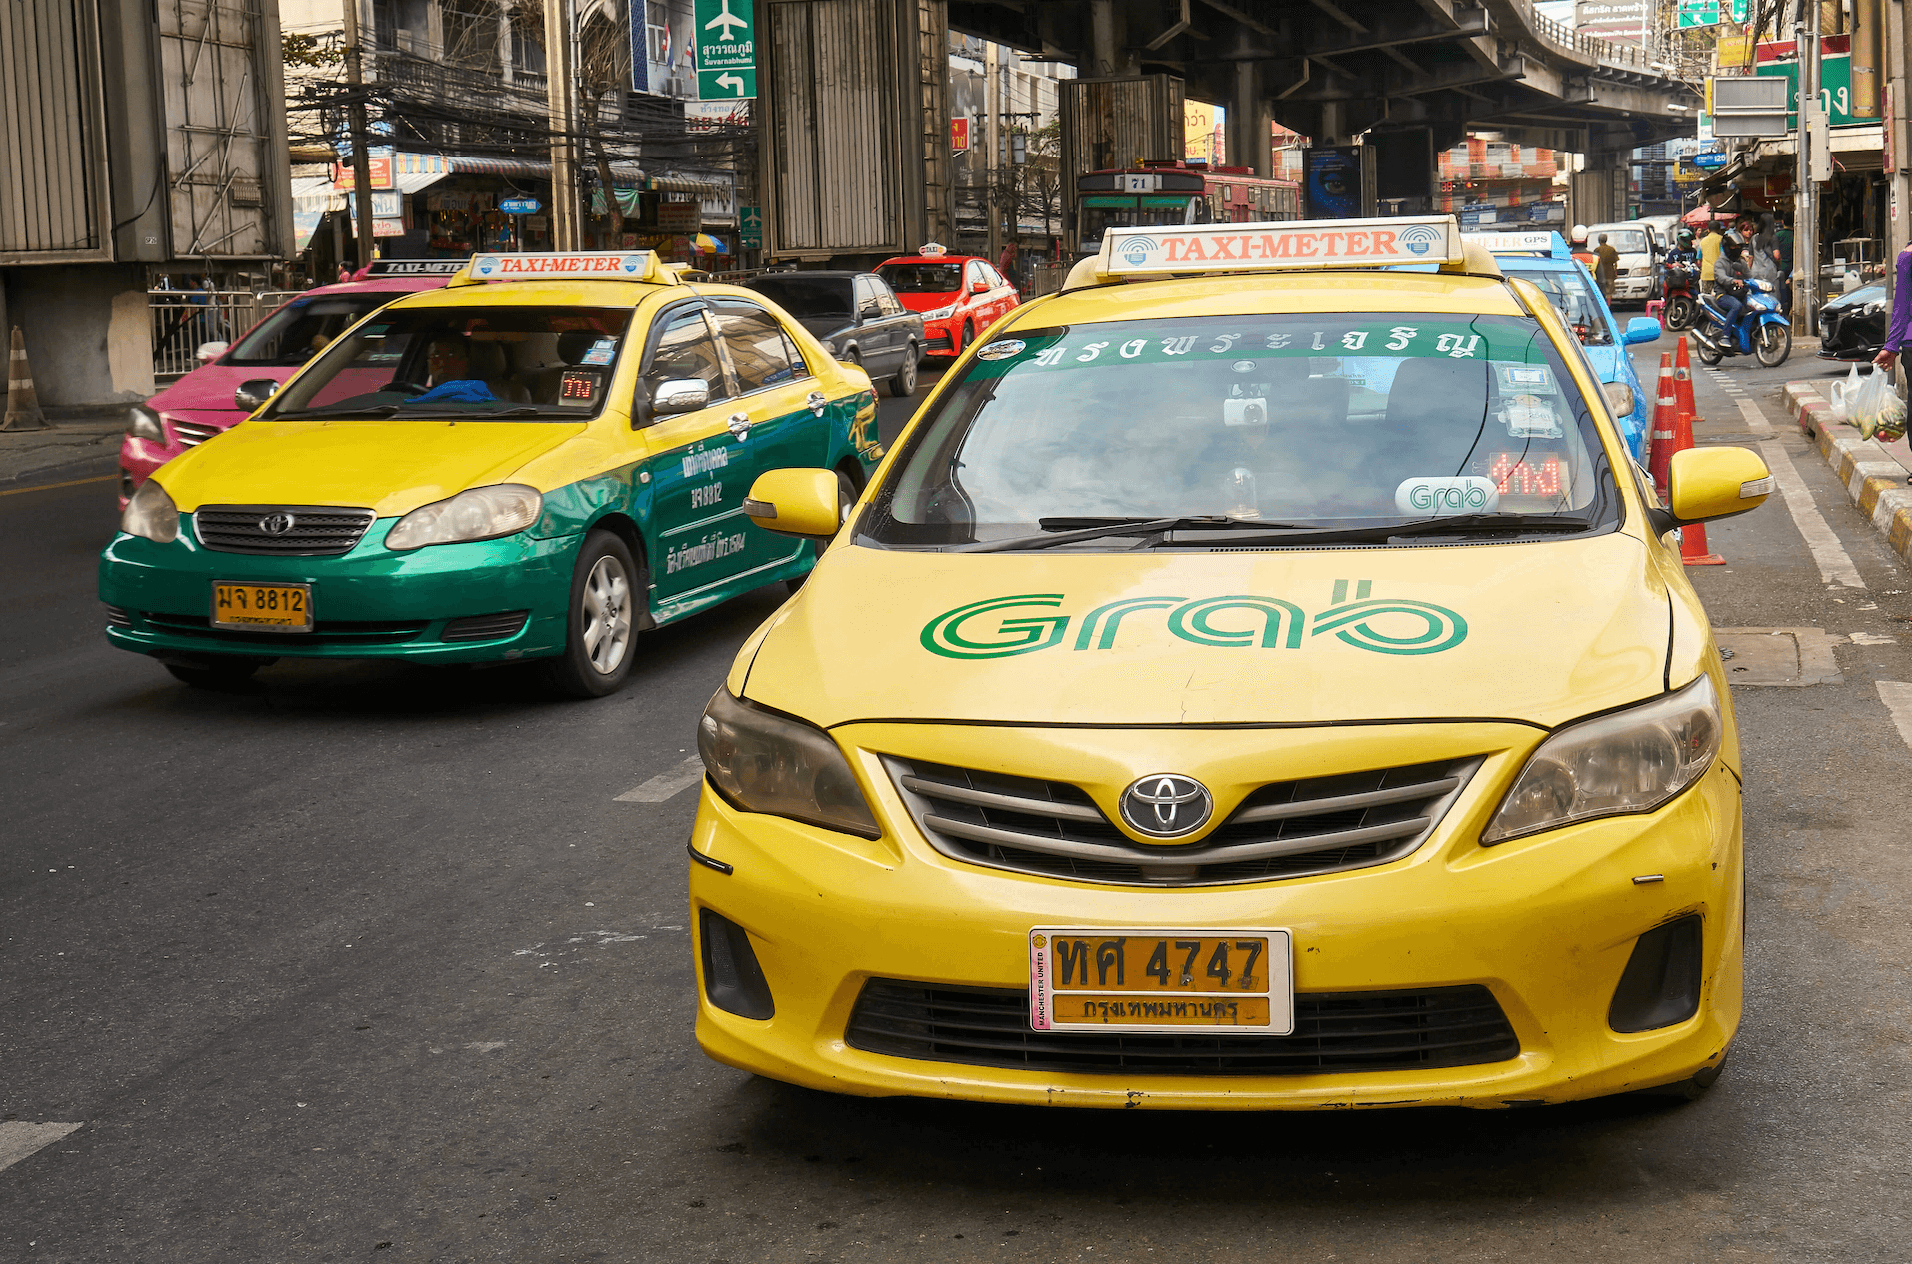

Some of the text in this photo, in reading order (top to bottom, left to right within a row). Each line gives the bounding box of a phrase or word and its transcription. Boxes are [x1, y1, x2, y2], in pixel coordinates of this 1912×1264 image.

[702, 40, 753, 58] สุวรรณภูมิ
[704, 56, 753, 65] Suvarnabhumi
[1131, 178, 1146, 189] 71
[1160, 230, 1399, 262] TAXI-METER
[1524, 236, 1548, 244] GPS
[500, 257, 621, 273] TAXI-METER
[1409, 479, 1487, 510] Grab
[218, 587, 303, 612] มจ 8812
[919, 579, 1469, 660] Grab
[1056, 937, 1262, 989] ทศ 4747
[1083, 1000, 1239, 1023] กรุงเทพมหานคร
